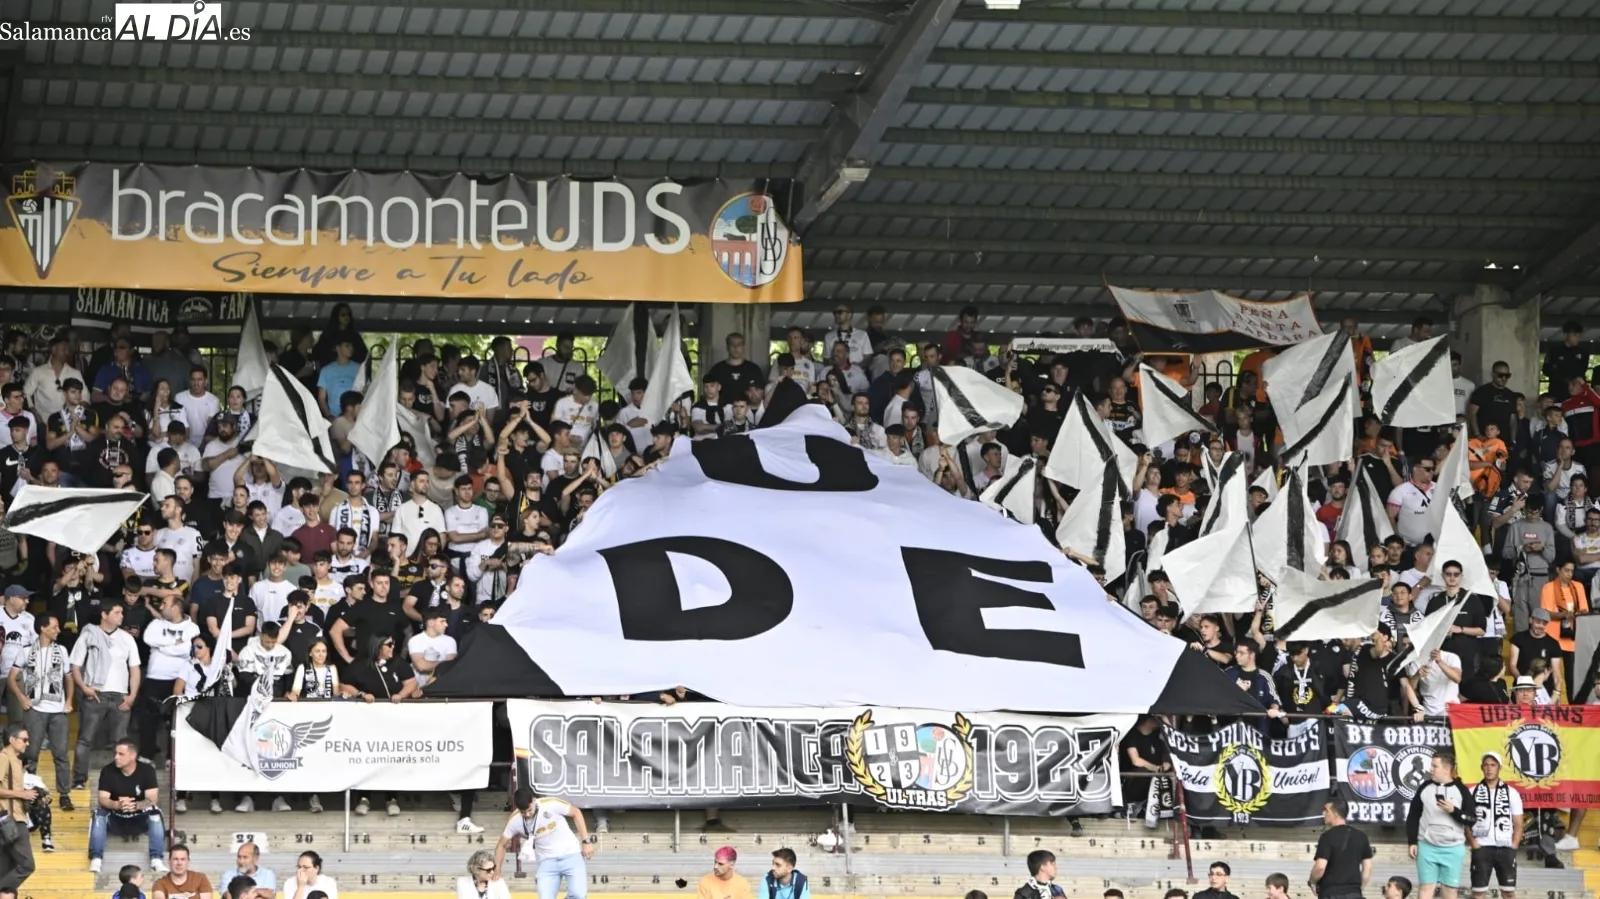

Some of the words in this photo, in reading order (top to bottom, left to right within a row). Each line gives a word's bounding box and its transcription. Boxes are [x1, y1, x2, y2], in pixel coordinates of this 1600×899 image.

[112, 169, 691, 254] bracamonteUDS
[212, 251, 375, 288] Siempre
[395, 267, 425, 280] a
[429, 255, 487, 286] Tu
[508, 258, 593, 293] lado
[76, 287, 169, 323] SALMANTICA
[1240, 304, 1289, 319] PEÑA
[691, 434, 879, 492] U
[595, 535, 794, 641] D
[900, 546, 1086, 669] E
[1480, 705, 1522, 724] UDS
[1531, 706, 1584, 725] FANS
[325, 738, 362, 753] PEÑA
[367, 740, 433, 753] VIAJEROS
[437, 740, 465, 753] UDS
[1270, 723, 1320, 757] BOYS
[1347, 724, 1374, 744] BY
[1384, 726, 1452, 747] ORDER
[271, 760, 295, 770] UNION
[365, 755, 417, 765] caminarás
[420, 755, 440, 764] sola
[529, 715, 862, 798] SALAMANCA
[886, 788, 948, 807] ULTRAS
[1346, 801, 1396, 822] PEPE
[236, 834, 254, 844] 22
